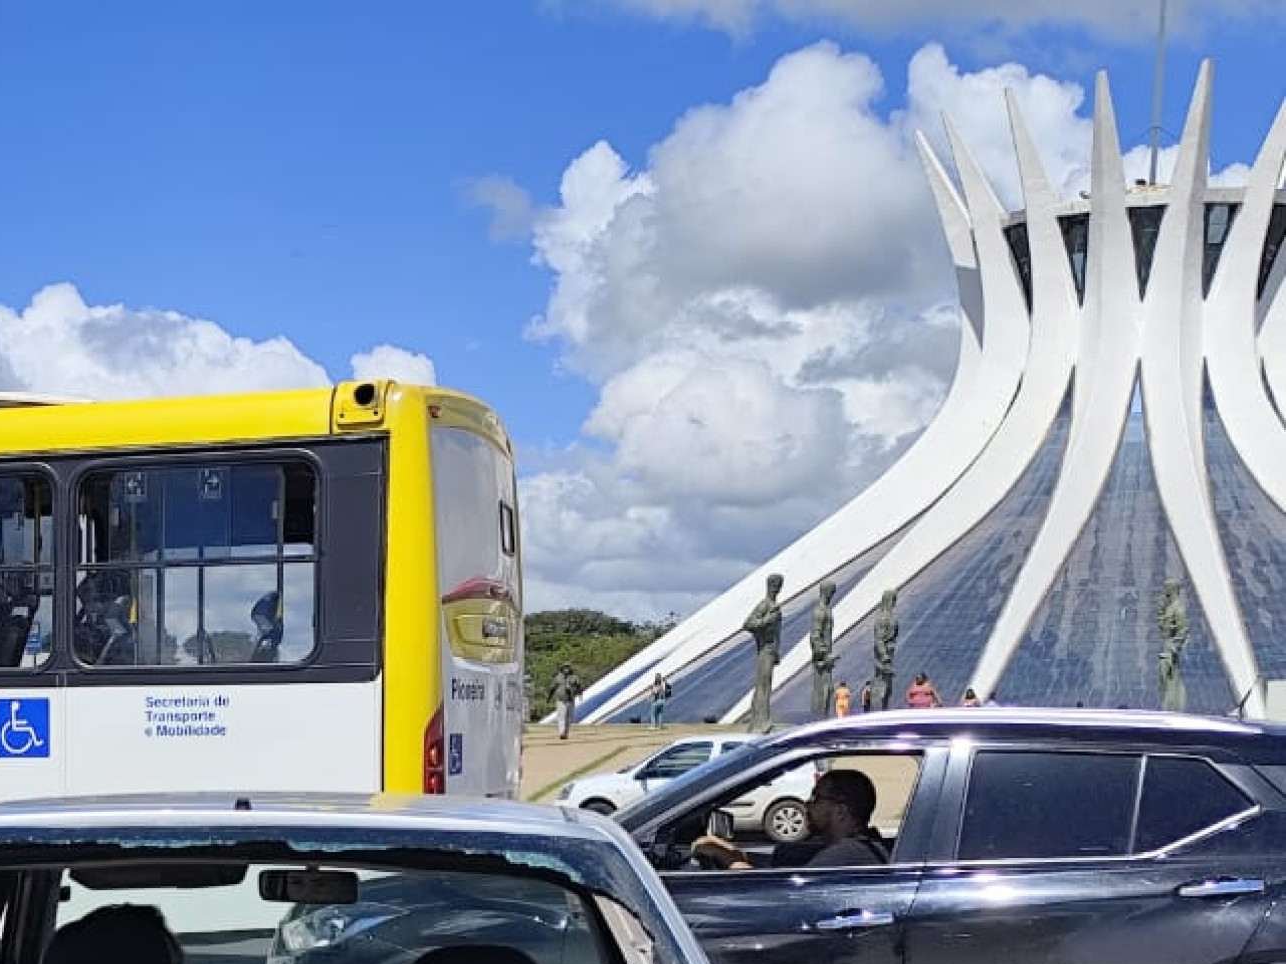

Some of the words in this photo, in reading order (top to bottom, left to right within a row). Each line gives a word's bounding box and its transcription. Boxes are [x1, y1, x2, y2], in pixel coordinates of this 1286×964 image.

[145, 696, 210, 708] Secretaria
[144, 711, 216, 723] Transporte
[156, 725, 226, 737] Mobilidade
